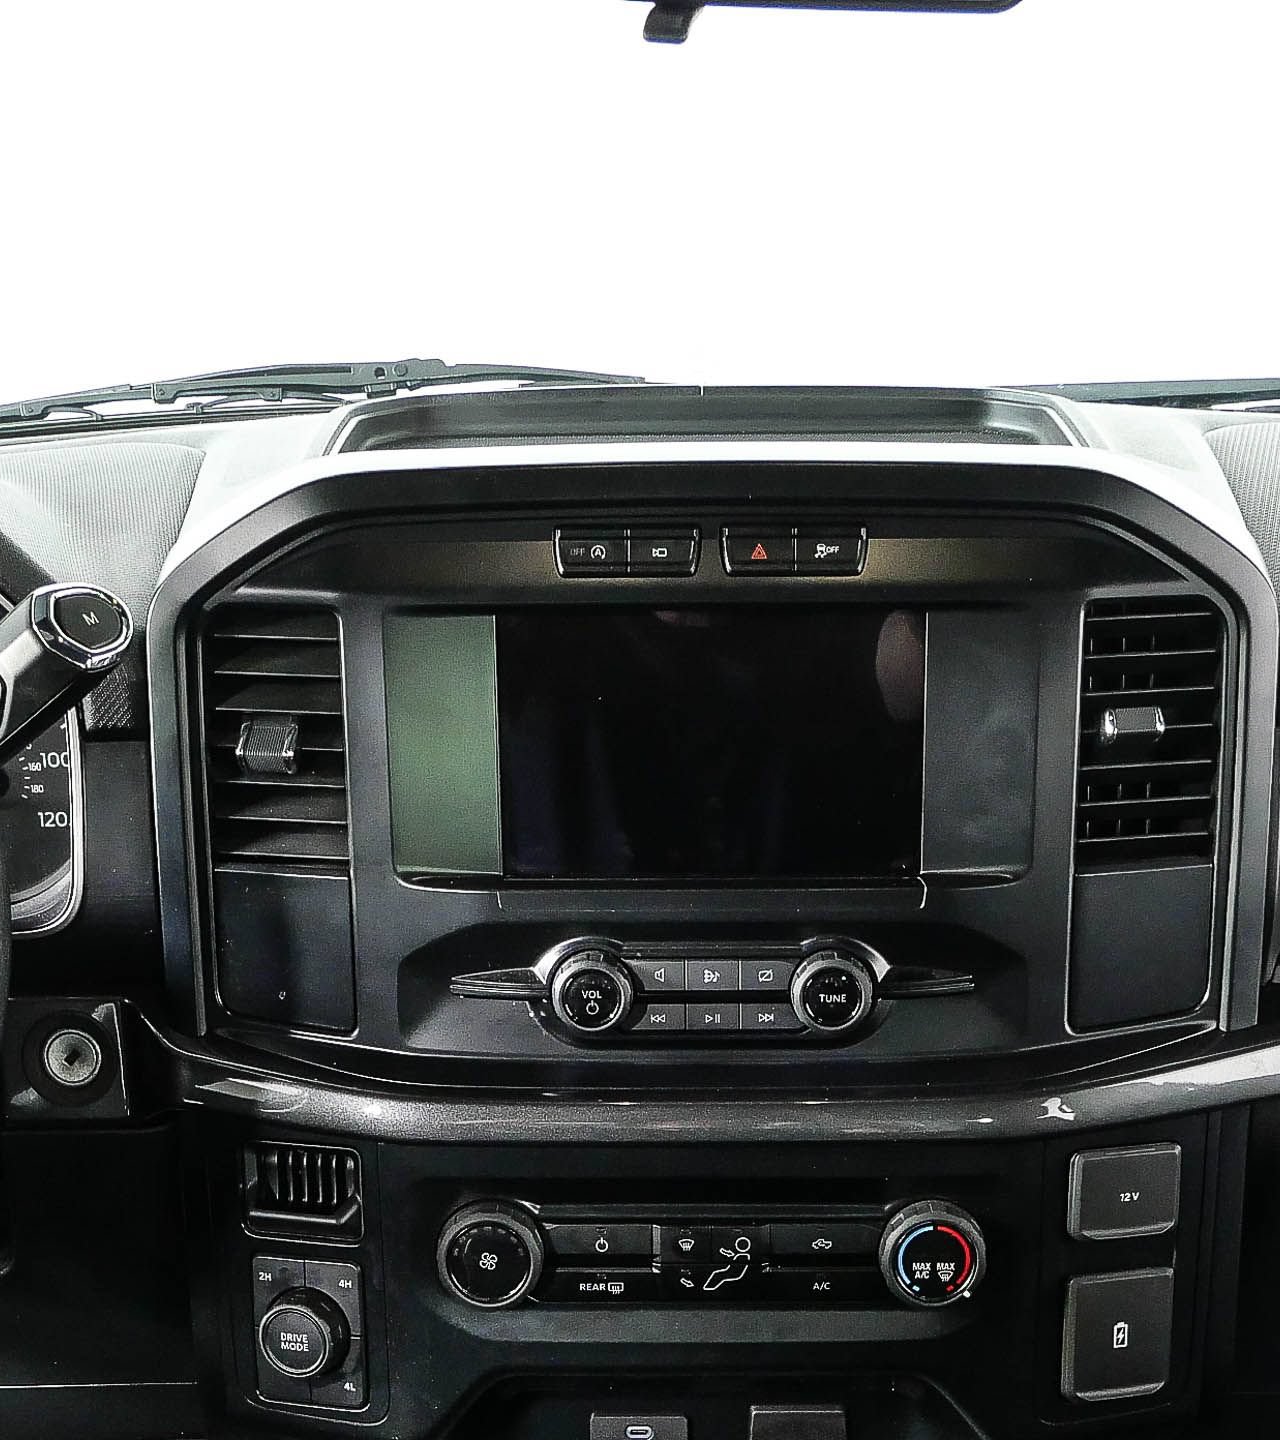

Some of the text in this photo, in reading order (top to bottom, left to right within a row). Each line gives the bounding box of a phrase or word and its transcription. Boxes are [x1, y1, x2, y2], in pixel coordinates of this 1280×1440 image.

[825, 545, 840, 554] OFF
[81, 611, 100, 627] M
[28, 762, 42, 771] 160
[30, 784, 44, 793] 180
[37, 811, 68, 828] 120
[580, 989, 603, 1000] VOL
[818, 993, 848, 1004] TUNE
[912, 1262, 956, 1271] MAX MAX
[258, 1271, 272, 1283] 2H
[914, 1270, 930, 1279] A/C
[338, 1278, 352, 1289] 4H
[579, 1282, 607, 1292] REAR
[812, 1281, 831, 1291] A/C
[280, 1332, 309, 1343] DRIVE
[280, 1341, 310, 1352] MODE
[343, 1381, 357, 1392] 4L
